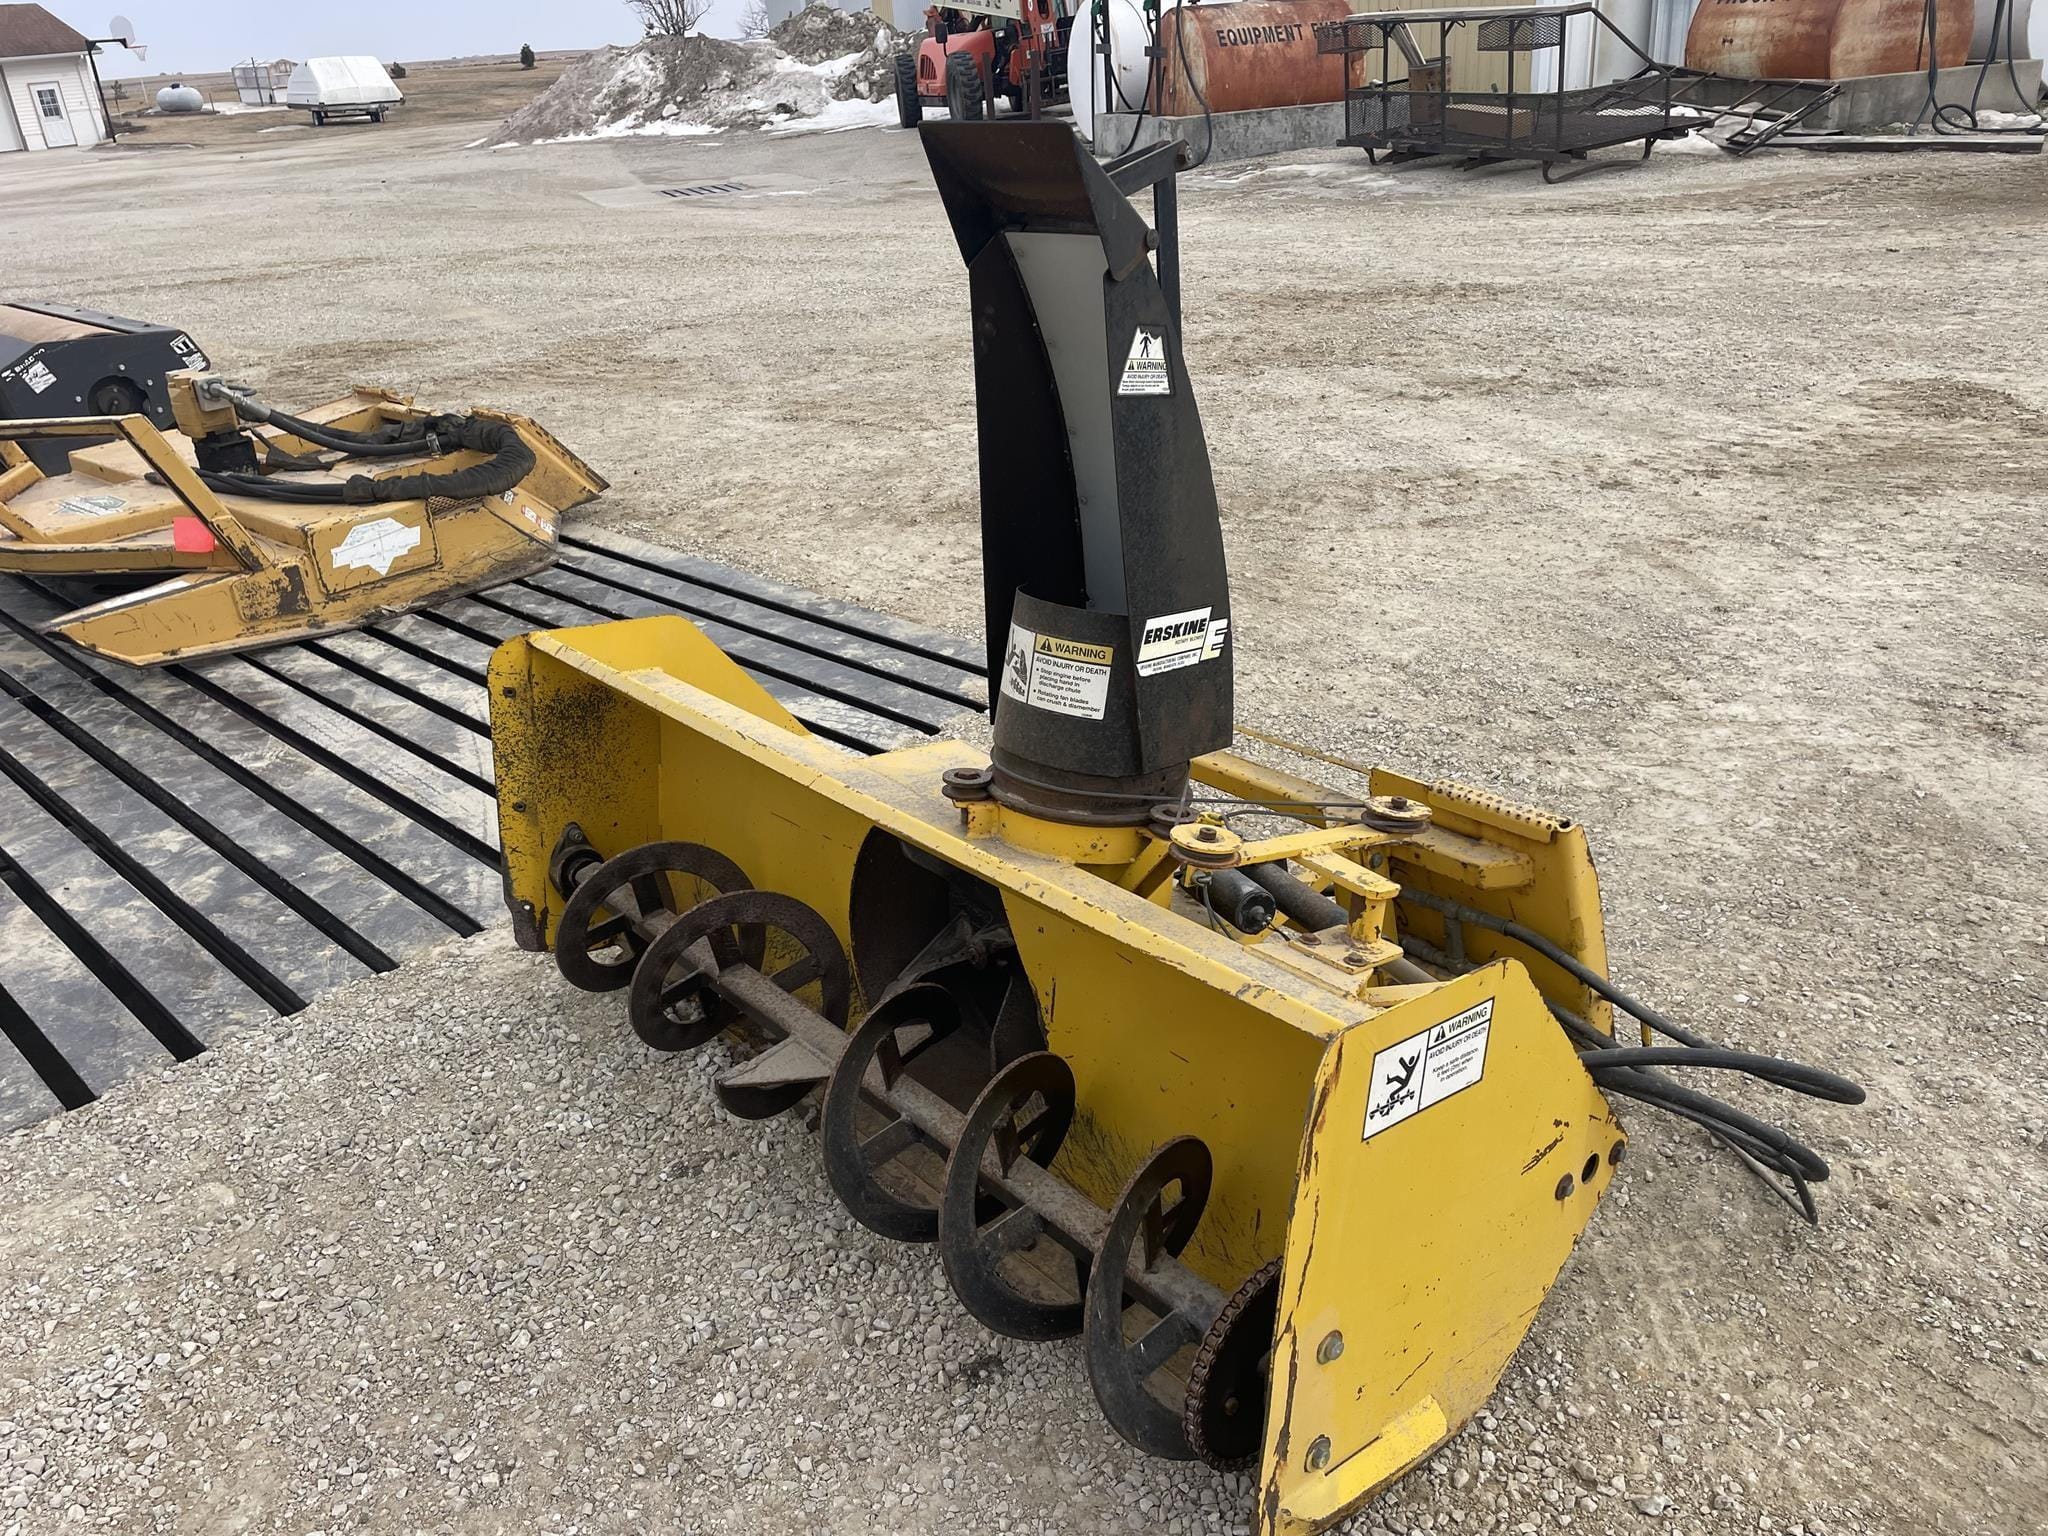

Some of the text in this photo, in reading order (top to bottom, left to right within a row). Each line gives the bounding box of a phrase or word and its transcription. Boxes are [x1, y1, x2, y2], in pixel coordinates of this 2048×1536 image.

[1216, 23, 1303, 47] EQUIPMENT
[1143, 617, 1207, 645] ERSKINE
[1055, 642, 1106, 660] WARNING
[1036, 656, 1107, 676] AVOID INJURY OR DEATH
[1040, 667, 1091, 683] Stop engine before
[1040, 674, 1058, 684] placing
[1059, 679, 1073, 687] hand
[1039, 680, 1081, 694] discharge chute
[1037, 689, 1059, 700] Rotating
[1070, 697, 1089, 705] blades
[1046, 698, 1062, 706] crush
[1068, 703, 1101, 713] dismember
[1448, 1006, 1488, 1033] WARNING
[1429, 1026, 1487, 1060] AVOID INJURY OR DEATH
[1461, 1056, 1474, 1065] when
[1432, 1064, 1445, 1074] Keep
